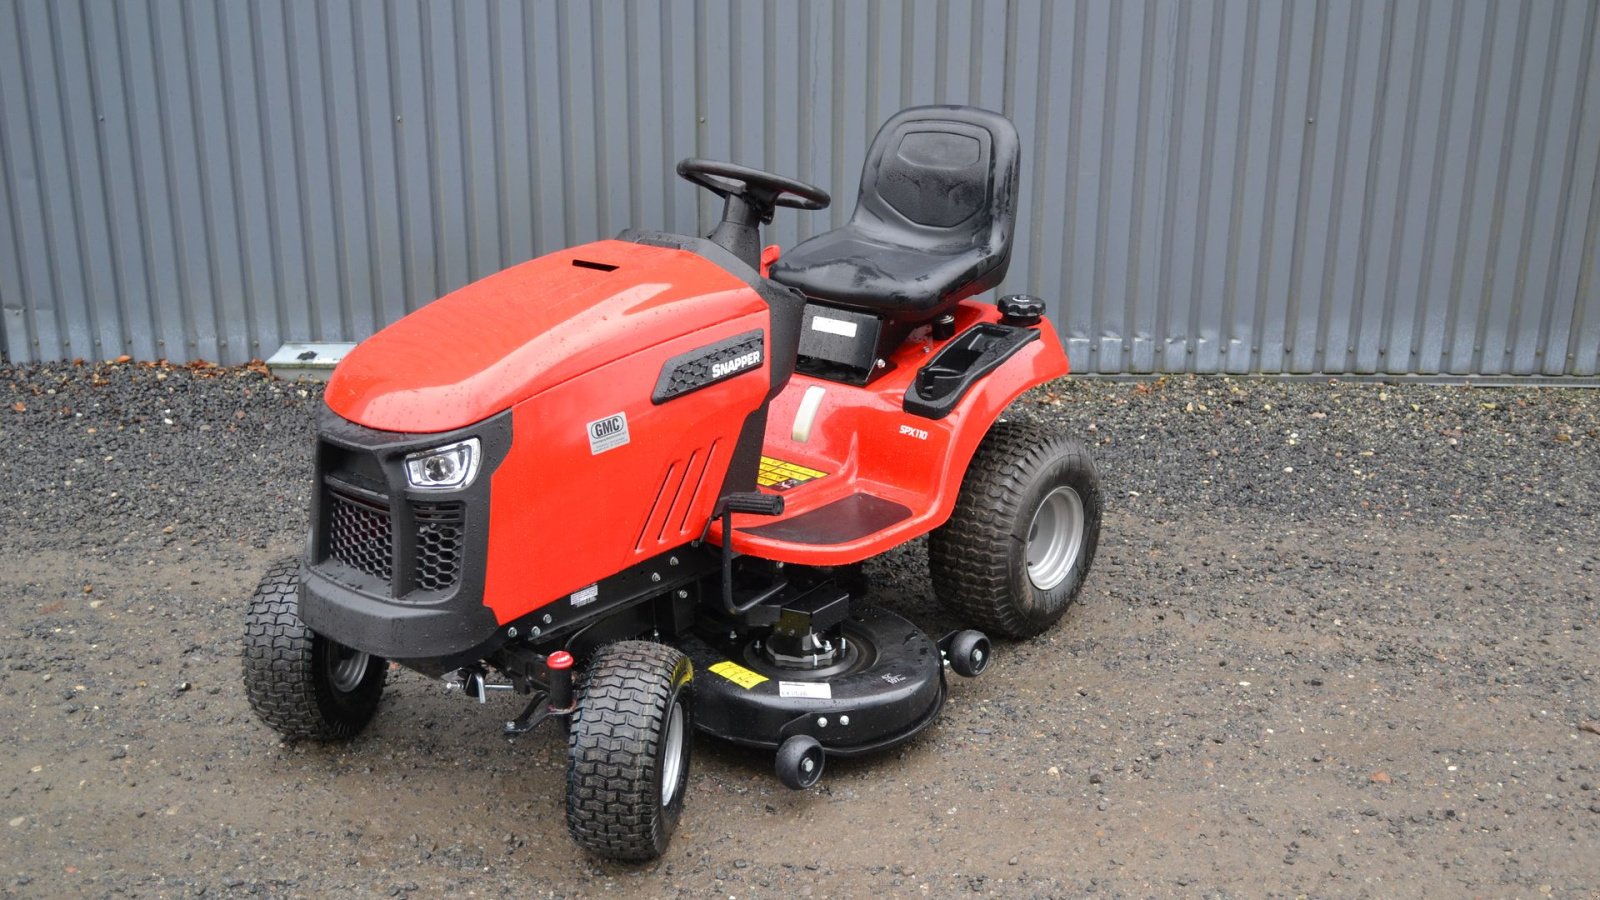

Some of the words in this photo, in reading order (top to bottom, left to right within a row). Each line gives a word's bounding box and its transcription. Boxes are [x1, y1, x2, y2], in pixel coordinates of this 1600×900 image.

[712, 351, 760, 378] SNAPPER
[595, 417, 620, 437] GMC
[899, 424, 928, 440] SPX110
